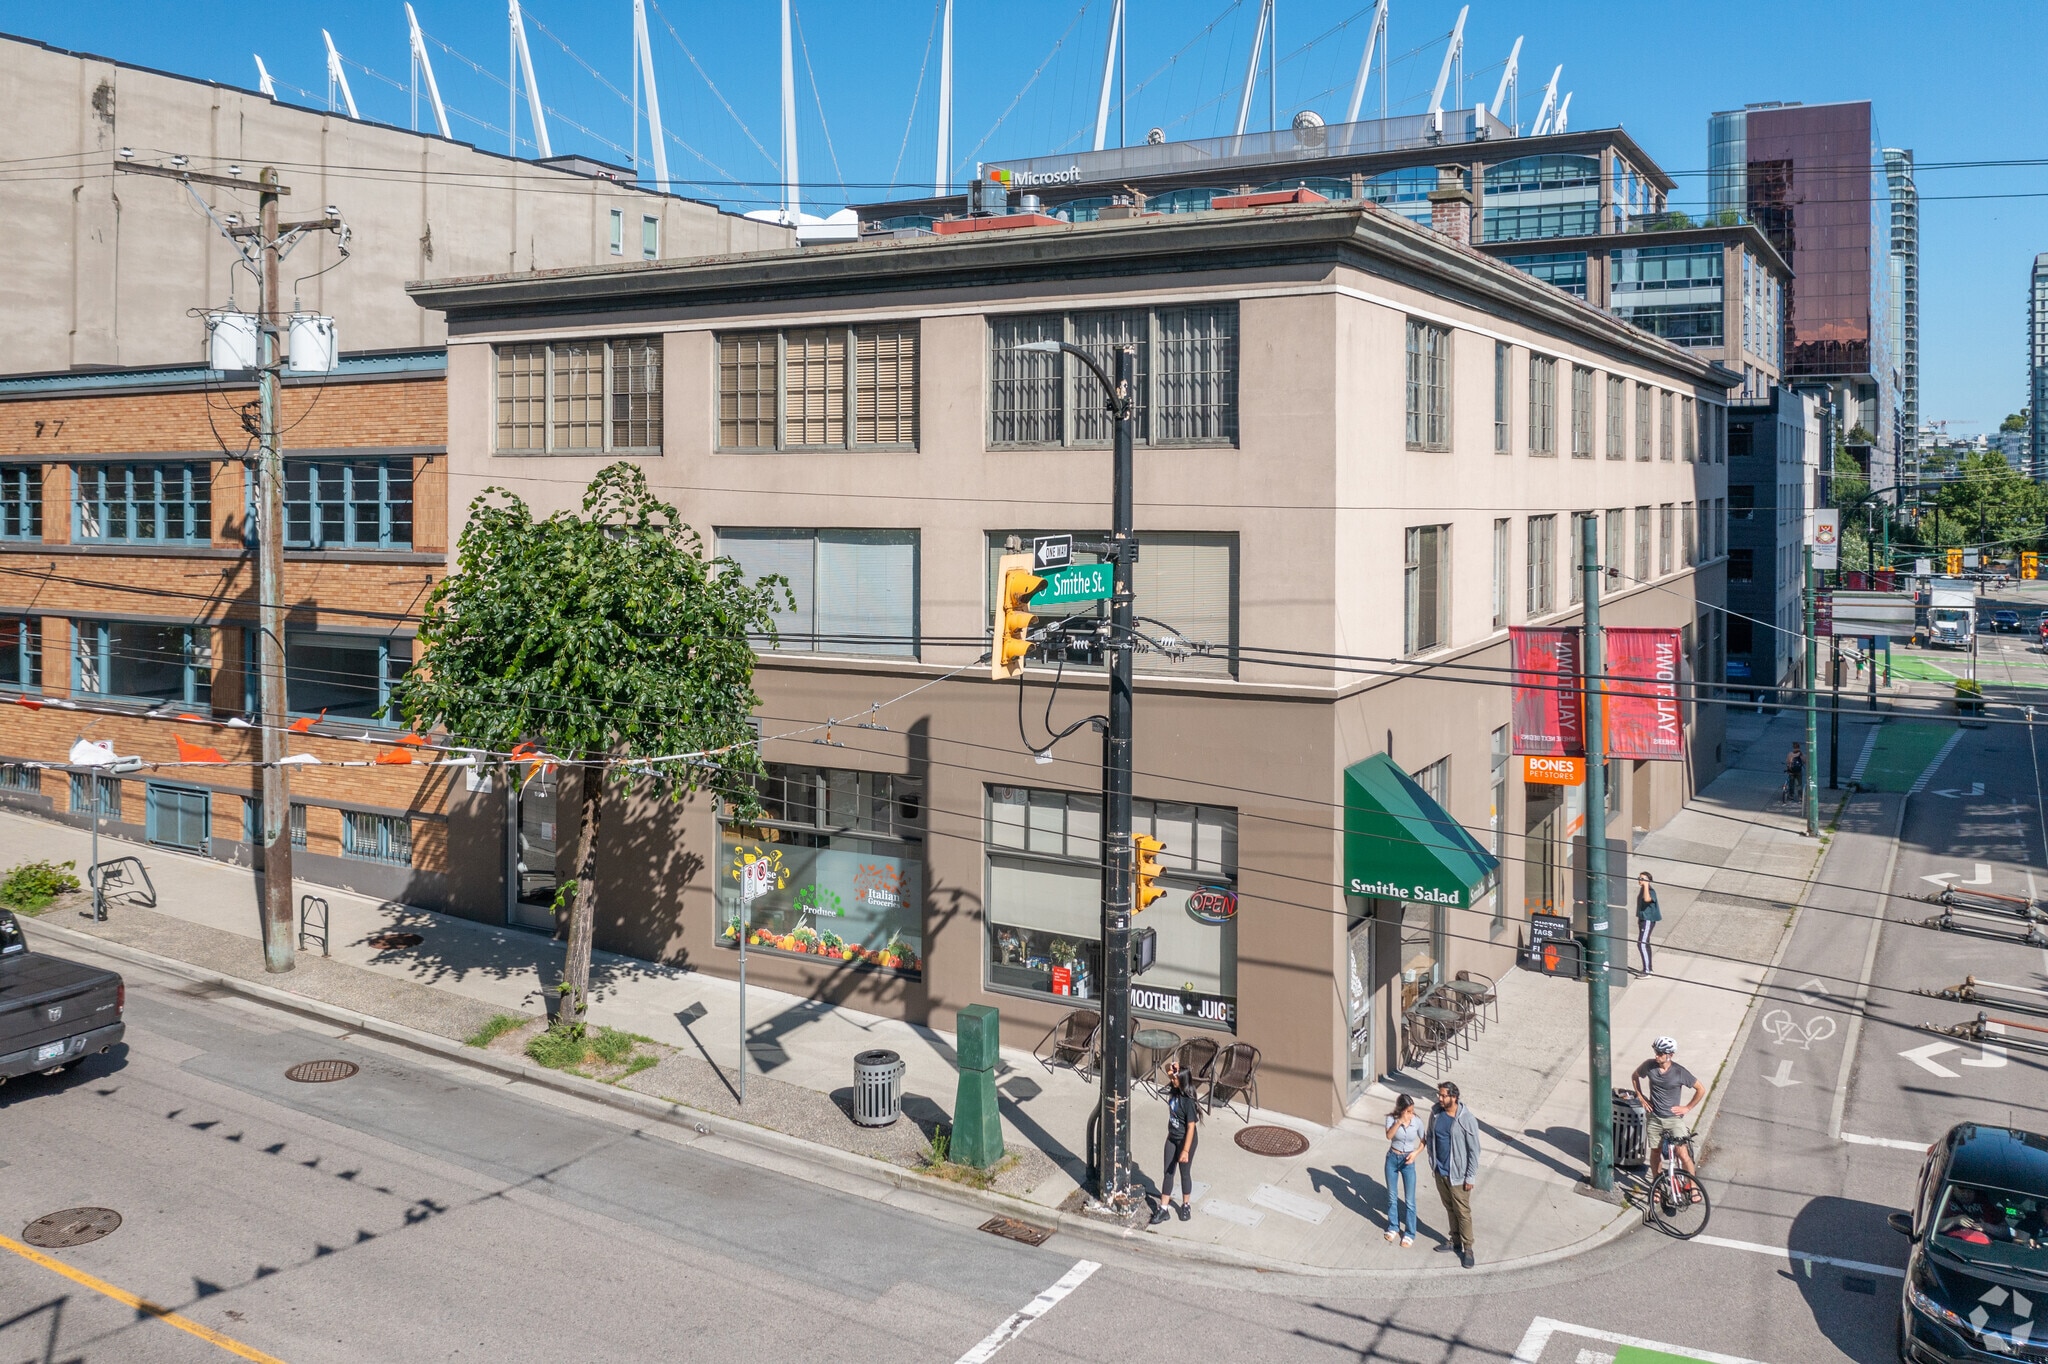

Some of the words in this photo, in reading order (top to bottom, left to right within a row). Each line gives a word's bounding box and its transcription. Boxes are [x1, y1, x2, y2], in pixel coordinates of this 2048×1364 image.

[1014, 165, 1081, 185] Microsoft
[1045, 546, 1055, 558] ONE
[1054, 571, 1090, 596] Smithe
[1092, 571, 1105, 593] St.
[1529, 758, 1574, 773] BONES
[1545, 771, 1574, 780] STORES
[867, 888, 900, 902] Italian
[1351, 879, 1409, 898] Smithe
[1414, 885, 1459, 904] Salad
[803, 904, 837, 918] Produce
[867, 898, 900, 909] Groceries
[1191, 893, 1236, 914] OPEN
[1131, 989, 1181, 1014] MOOTHIE
[1198, 1000, 1235, 1021] JUICE
